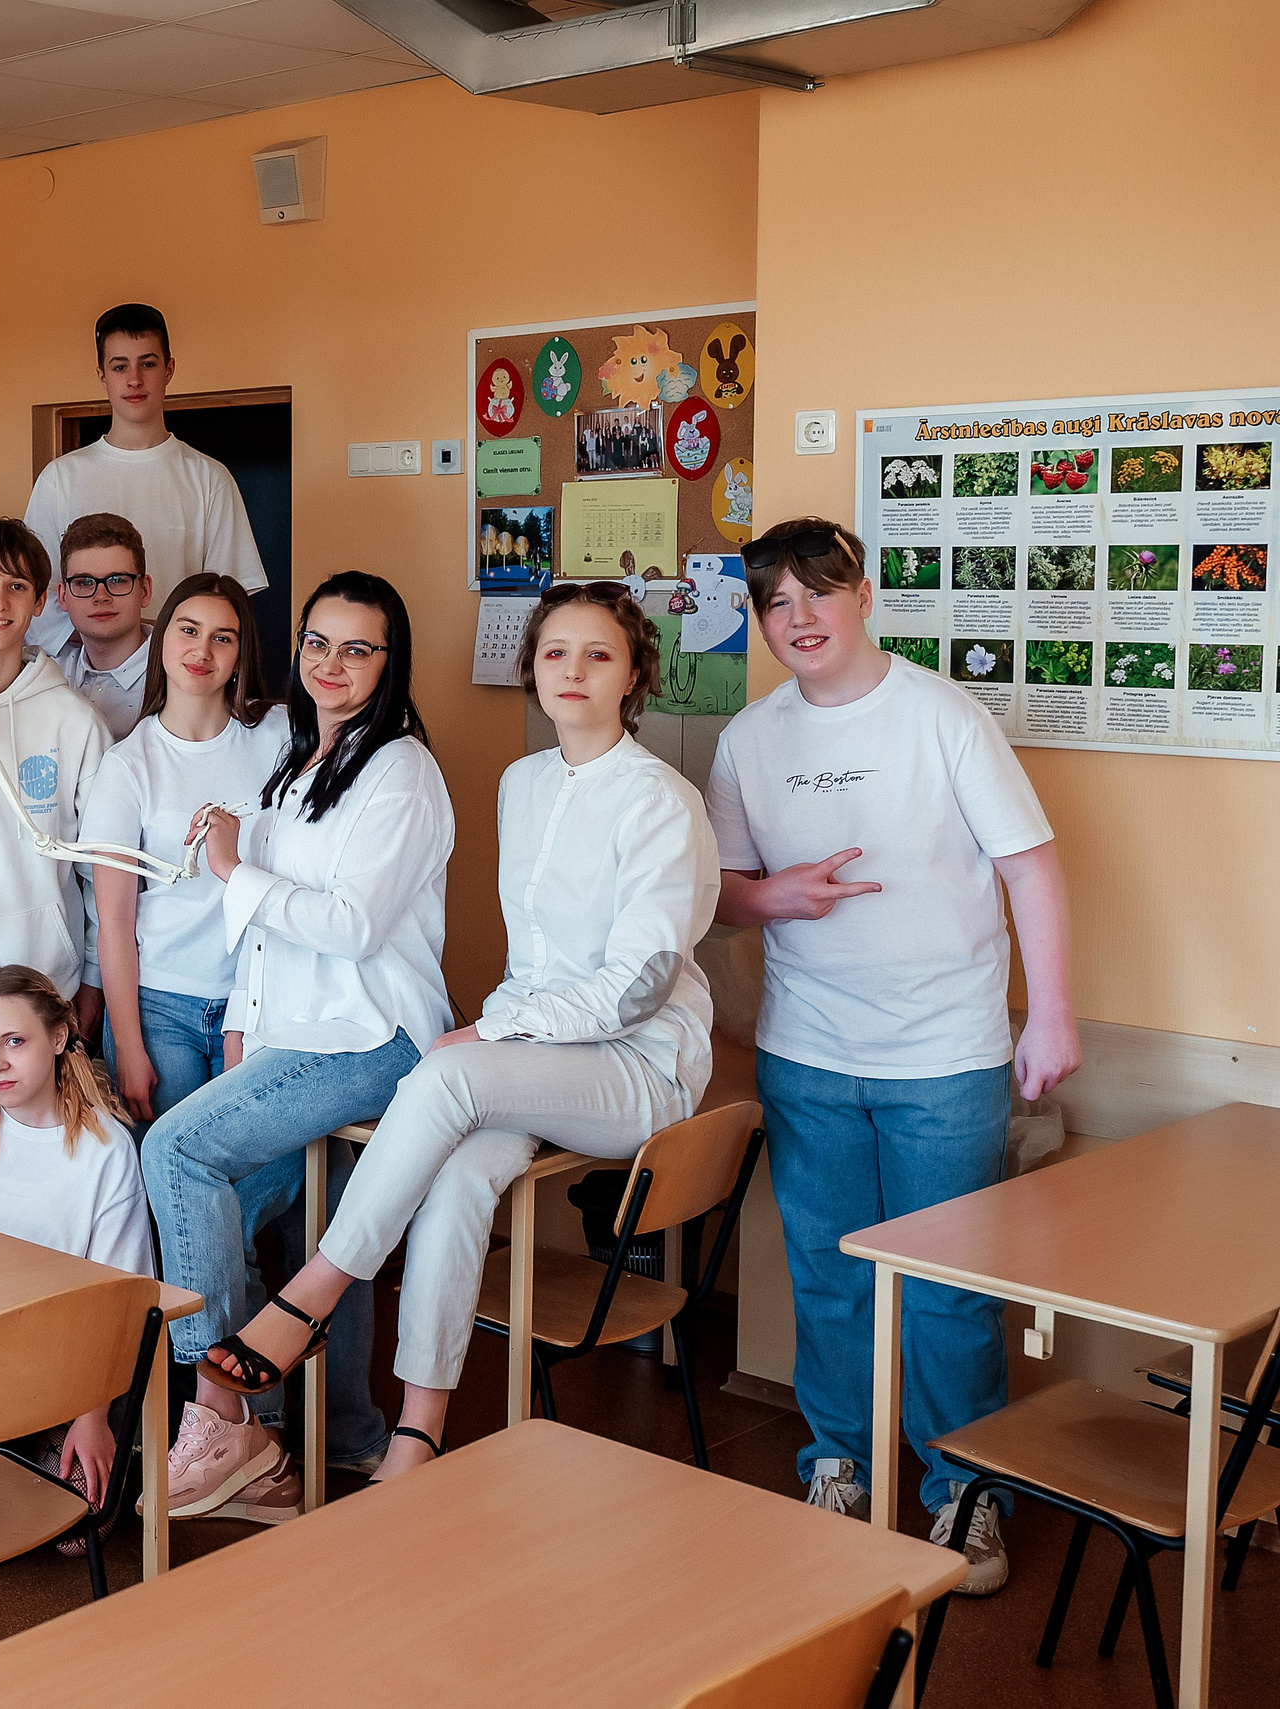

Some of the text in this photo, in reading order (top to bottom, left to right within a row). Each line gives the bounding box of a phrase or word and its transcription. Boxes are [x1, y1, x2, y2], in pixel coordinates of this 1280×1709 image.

[916, 419, 1047, 441] Ārstniecības
[1052, 415, 1101, 438] augi
[1108, 411, 1223, 432] Krāslavas
[670, 600, 684, 609] 2025
[786, 770, 880, 793] The Boston
